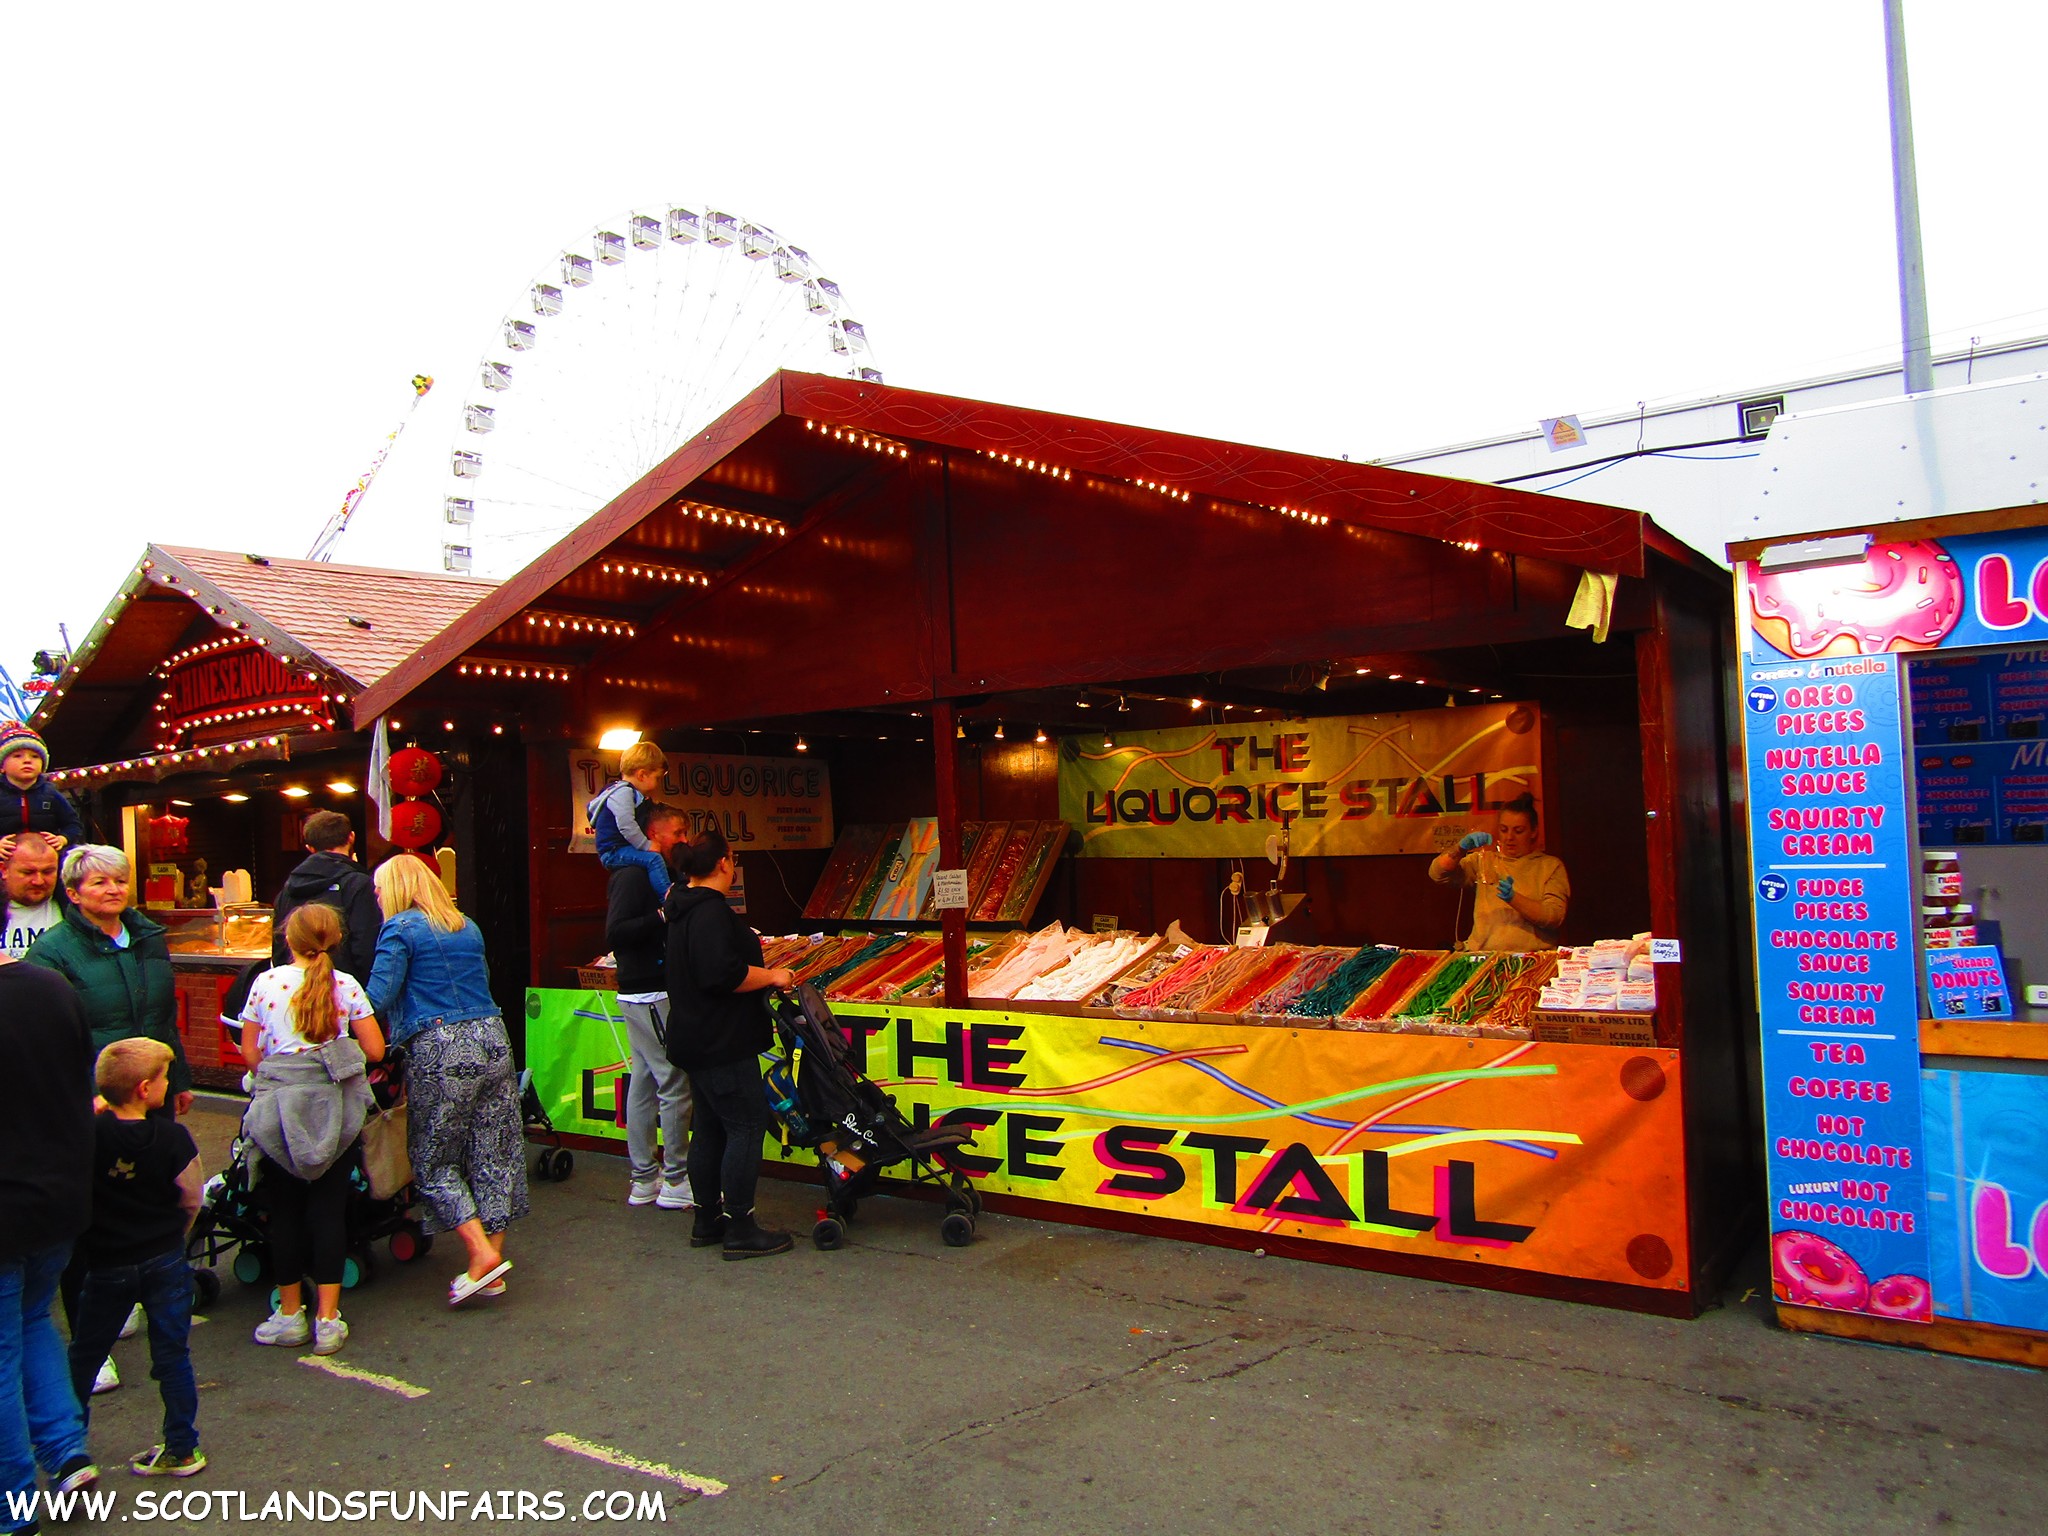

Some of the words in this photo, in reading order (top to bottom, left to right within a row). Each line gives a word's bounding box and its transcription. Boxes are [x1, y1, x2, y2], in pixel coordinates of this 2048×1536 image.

[1750, 668, 1804, 680] OREO
[1807, 663, 1820, 679] &
[1825, 659, 1886, 676] nutella
[1757, 699, 1765, 711] 1
[1784, 684, 1854, 709] OREO
[1777, 709, 1866, 735] PIECES
[1211, 732, 1310, 775] THE
[1766, 743, 1881, 770] NUTELLA
[663, 761, 820, 797] LIQUORICE
[1782, 771, 1867, 796] SAUCE
[1086, 781, 1330, 825] LIQUORICE
[1339, 774, 1506, 819] STALL
[689, 809, 756, 842] TALL
[1768, 805, 1885, 831] SQUIRTY
[1782, 833, 1874, 856] CREAM
[1761, 880, 1785, 889] OPTION
[1767, 887, 1777, 899] 2
[1796, 878, 1864, 897] FUDGE
[1794, 901, 1869, 921] PIECES
[1654, 941, 1674, 950] Brandy
[1770, 929, 1898, 950] CHOCOLATE
[1798, 953, 1870, 974] SAUCE
[1952, 957, 1995, 970] SUGARED
[1930, 969, 2002, 989] DONUTS
[1787, 981, 1885, 1003] SQUIRTY
[1599, 1017, 1624, 1025] SONS
[1628, 1018, 1648, 1026] LTD.
[1798, 1004, 1876, 1026] CREAM
[1609, 1033, 1650, 1041] ICEBERG
[833, 1014, 1027, 1090] THE
[1808, 1042, 1866, 1065] TEA
[1788, 1075, 1891, 1103] COFFEE
[1816, 1113, 1865, 1137] HOT
[1776, 1136, 1912, 1169] CHOCOLATE
[1094, 1125, 1536, 1248] STALL
[1788, 1181, 1839, 1195] LUXURY
[1840, 1178, 1890, 1203] HOT
[1778, 1198, 1915, 1234] CHOCOLATE
